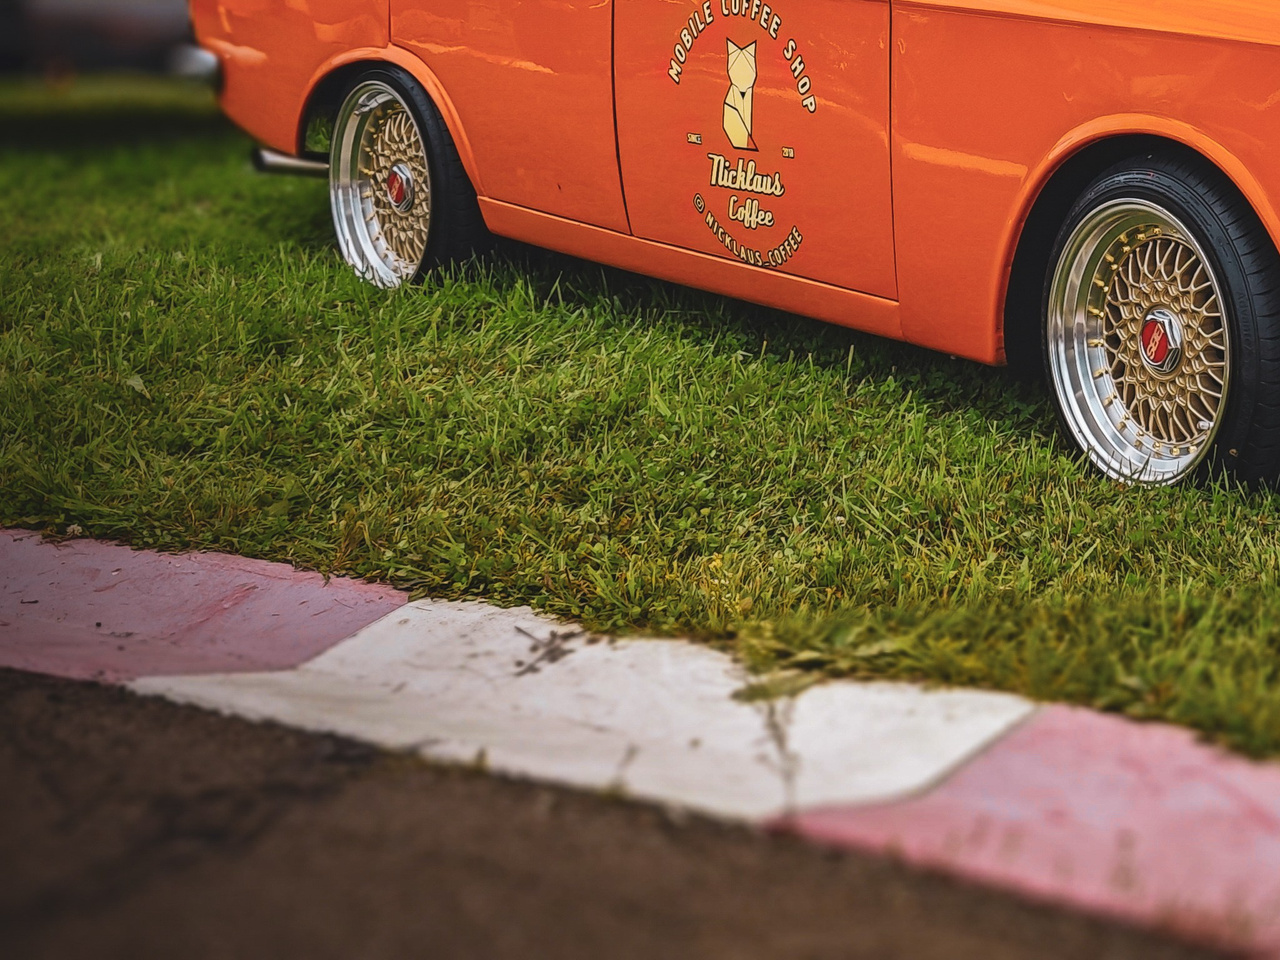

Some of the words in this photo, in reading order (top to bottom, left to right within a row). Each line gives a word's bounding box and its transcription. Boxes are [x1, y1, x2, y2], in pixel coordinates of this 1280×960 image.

[668, 0, 714, 85] MOBILE
[783, 38, 817, 114] SHOP
[707, 152, 785, 197] Nicklaus
[728, 195, 775, 230] Coffee
[705, 211, 803, 267] NICKLAUS_COFFEE
